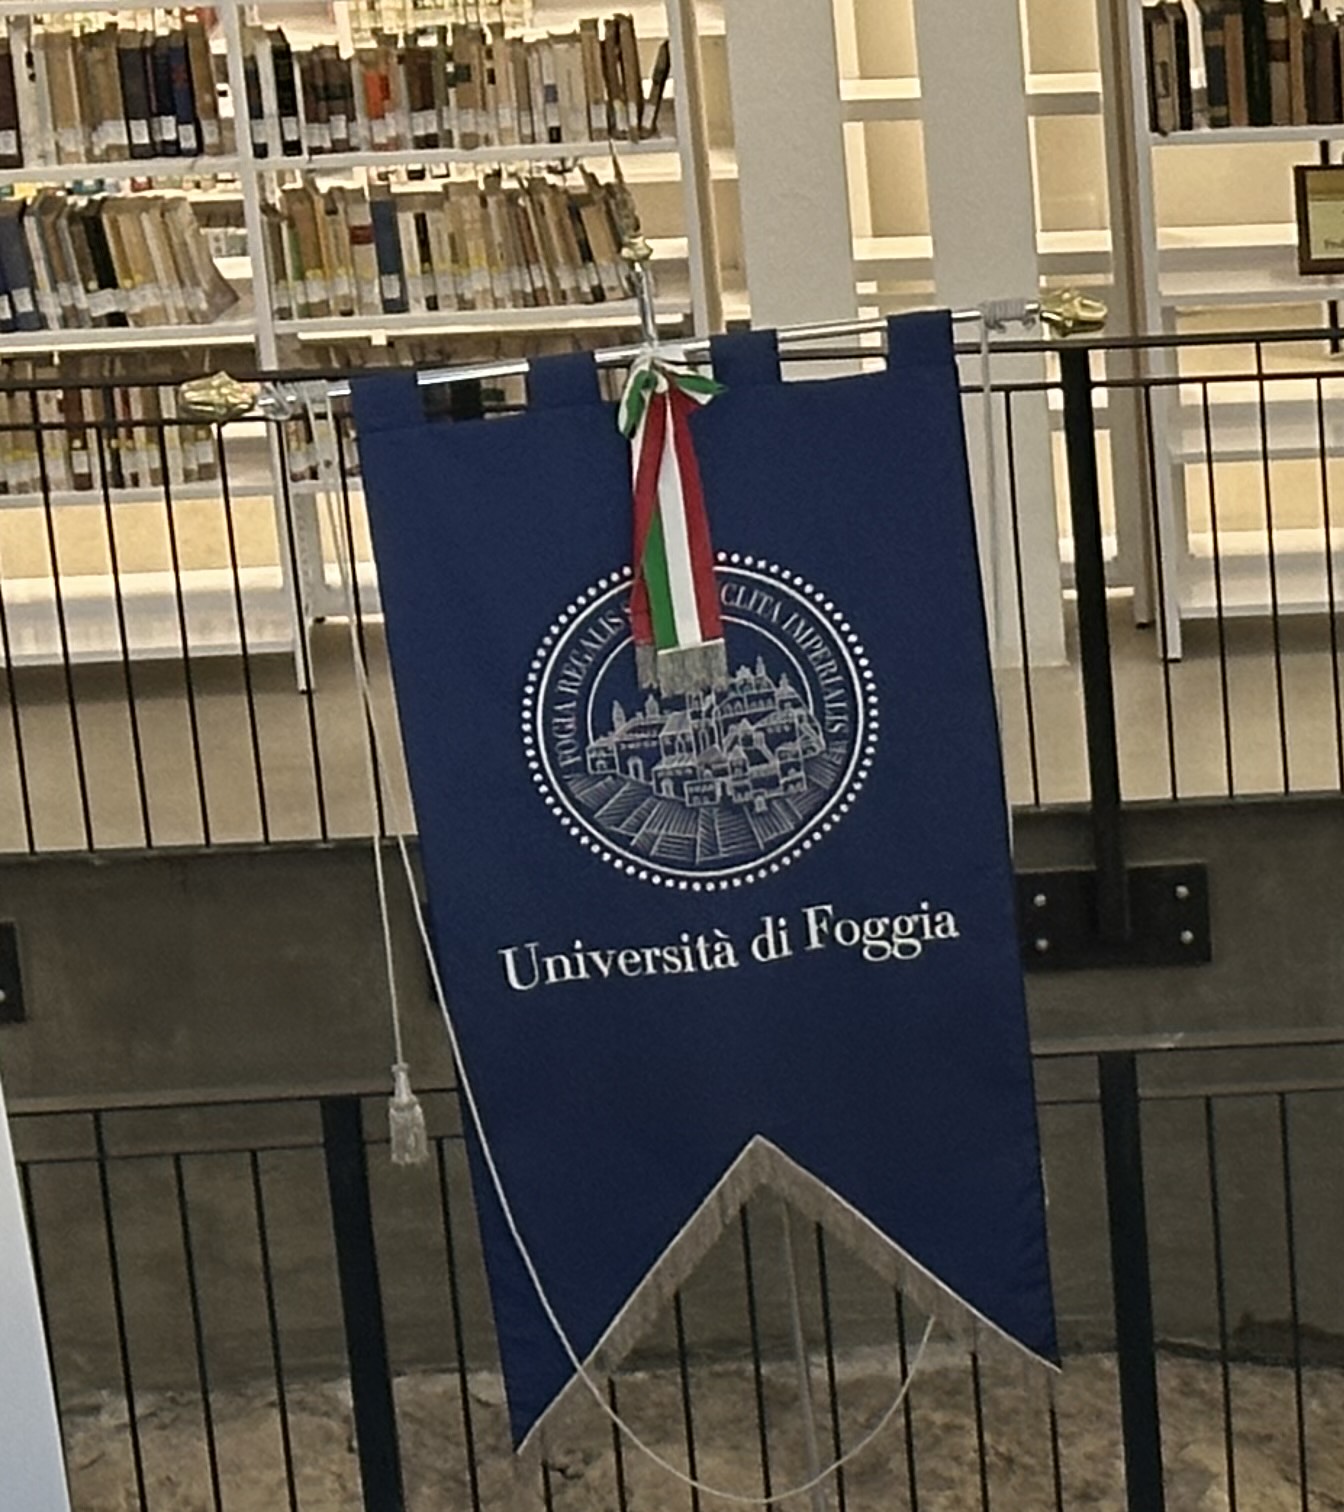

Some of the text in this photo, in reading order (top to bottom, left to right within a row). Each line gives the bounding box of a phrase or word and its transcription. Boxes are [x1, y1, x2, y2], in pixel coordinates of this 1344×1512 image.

[552, 609, 625, 767] FOGIA REGALIS
[781, 612, 849, 734] IMPERIALIS
[498, 901, 961, 992] Università di Foggia
